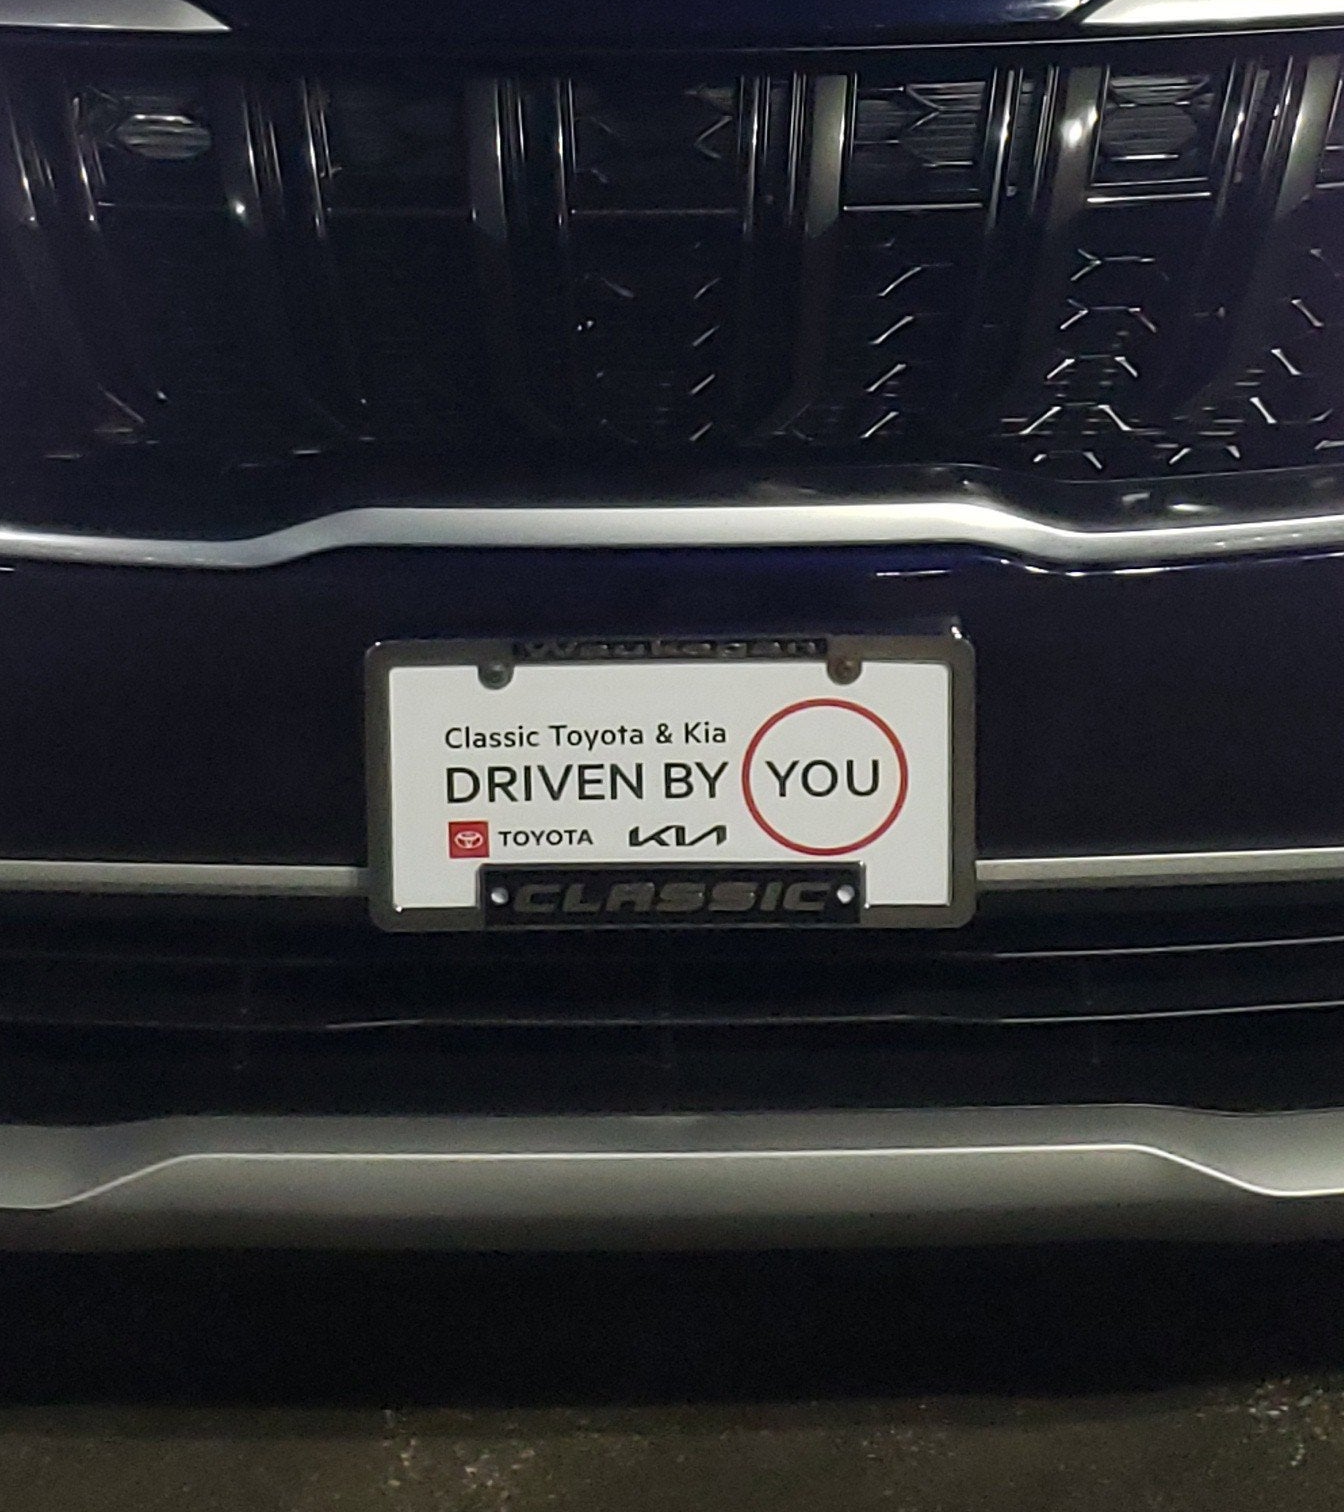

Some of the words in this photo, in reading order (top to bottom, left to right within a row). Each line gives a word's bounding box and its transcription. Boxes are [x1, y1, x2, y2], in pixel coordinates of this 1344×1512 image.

[445, 725, 539, 749] Classic
[548, 724, 644, 752] Toyota
[655, 722, 673, 744] &
[684, 721, 727, 744] Kia
[446, 762, 644, 804] DRIVEN
[664, 761, 729, 800] BY
[765, 758, 880, 798] YOU
[498, 829, 594, 847] TOYOTA
[512, 881, 832, 912] CLASSIC
